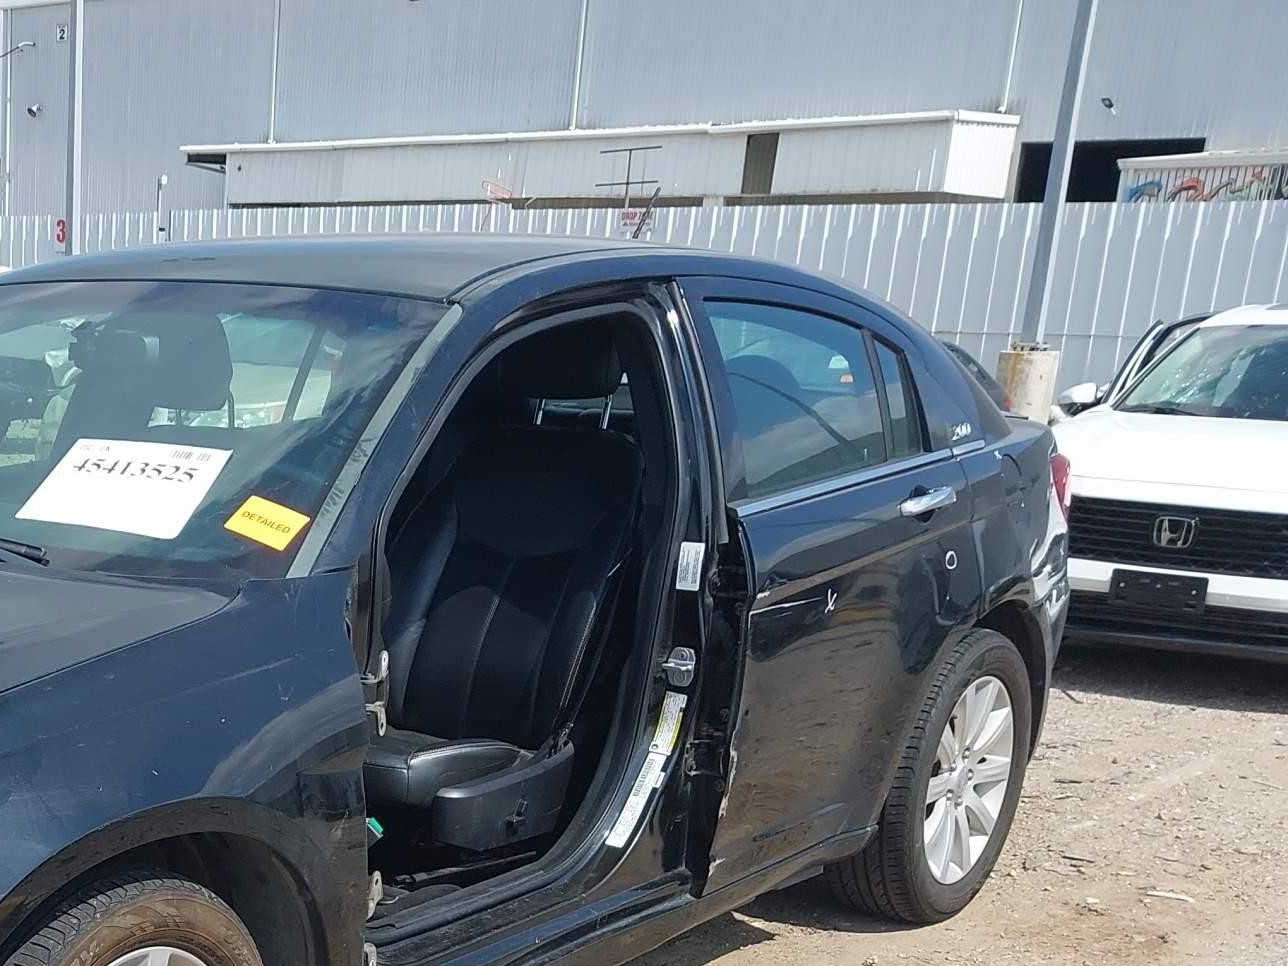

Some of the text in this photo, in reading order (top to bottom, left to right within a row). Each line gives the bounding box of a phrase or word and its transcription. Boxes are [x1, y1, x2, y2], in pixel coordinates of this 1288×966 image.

[59, 28, 65, 40] 2
[56, 219, 66, 244] 3
[73, 457, 199, 483] 45413525
[241, 510, 291, 534] DETAILED
